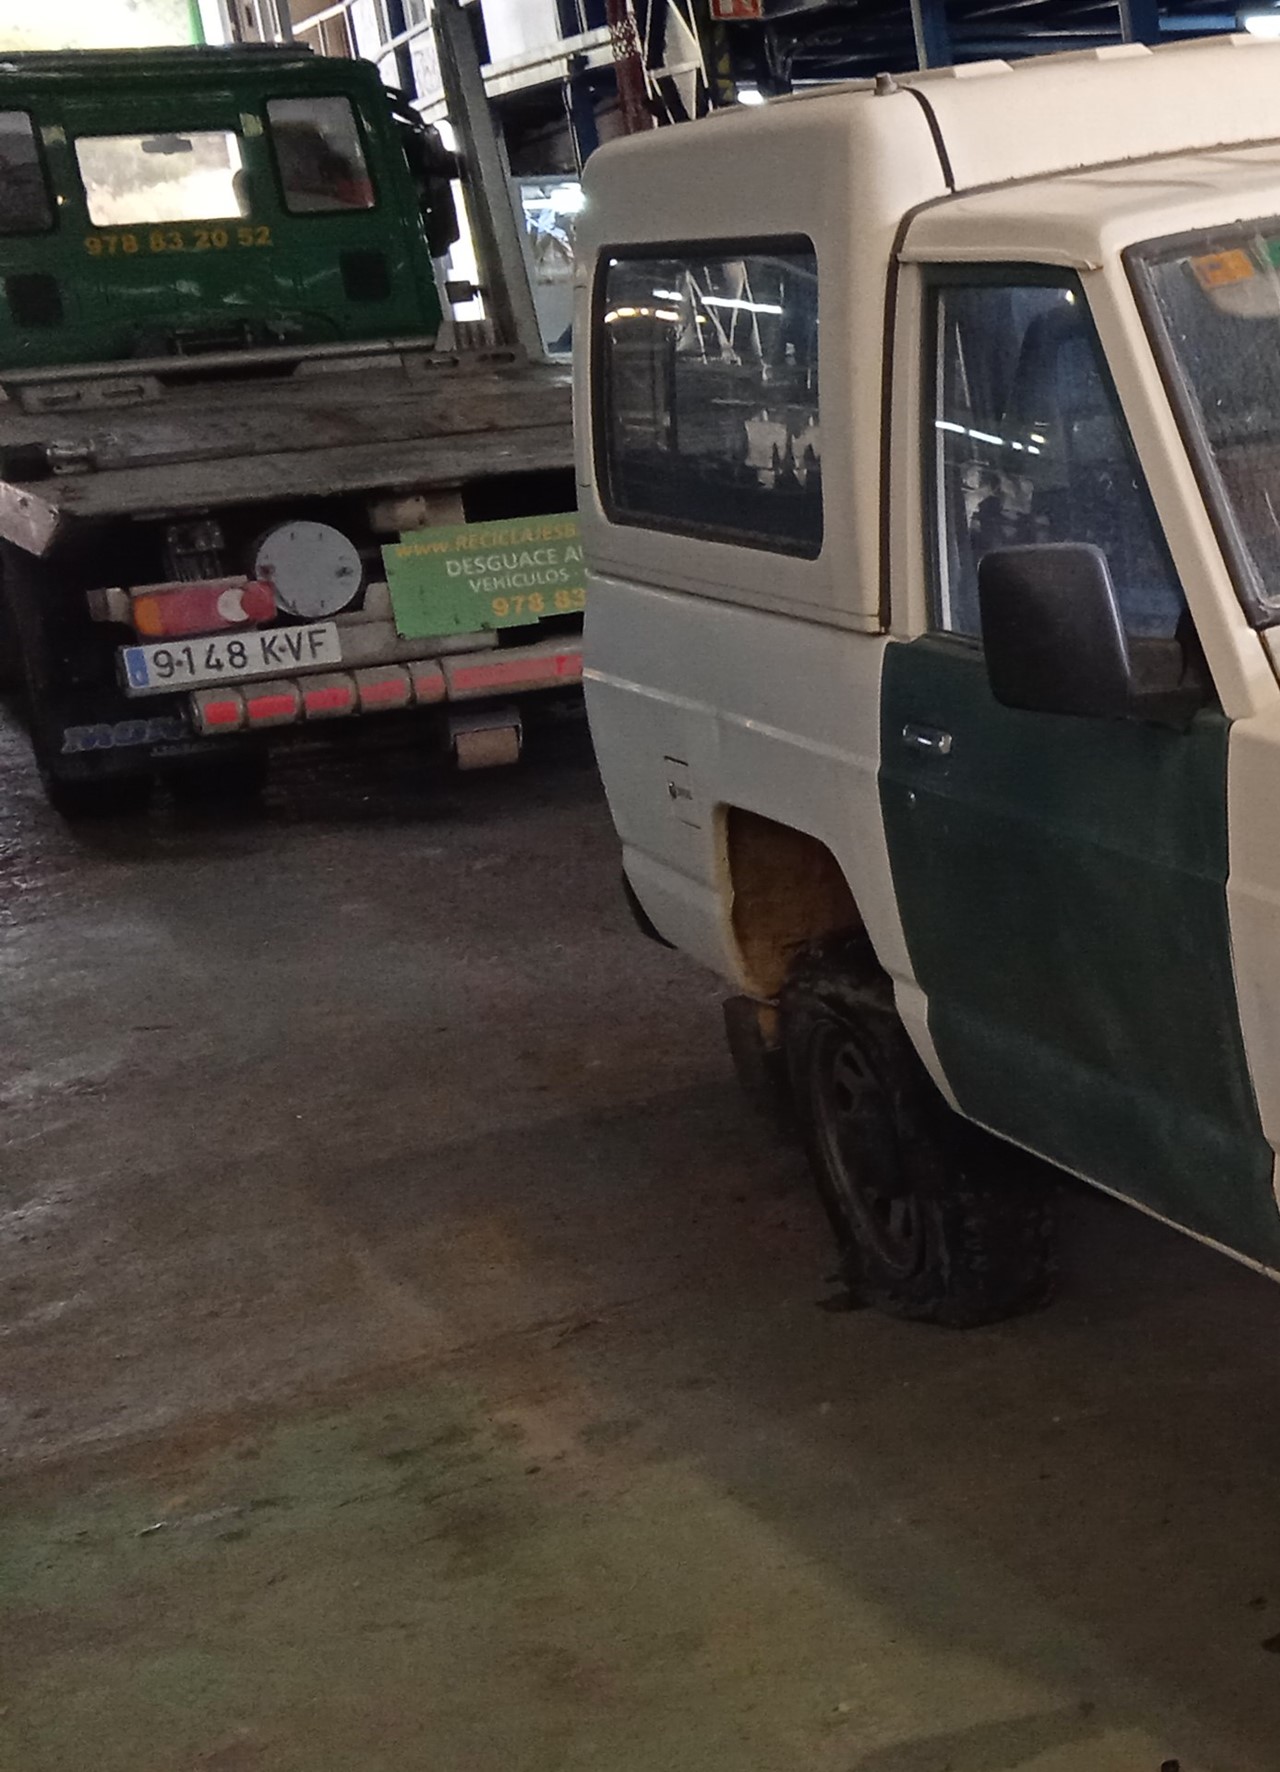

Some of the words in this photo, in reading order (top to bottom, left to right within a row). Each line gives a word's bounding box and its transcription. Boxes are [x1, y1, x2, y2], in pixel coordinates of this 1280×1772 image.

[84, 234, 139, 256] 978
[151, 231, 184, 251] 83
[193, 228, 228, 250] 20
[237, 226, 273, 247] 52
[446, 549, 559, 577] DESGUACE
[491, 592, 545, 617] 978
[554, 587, 586, 610] 83
